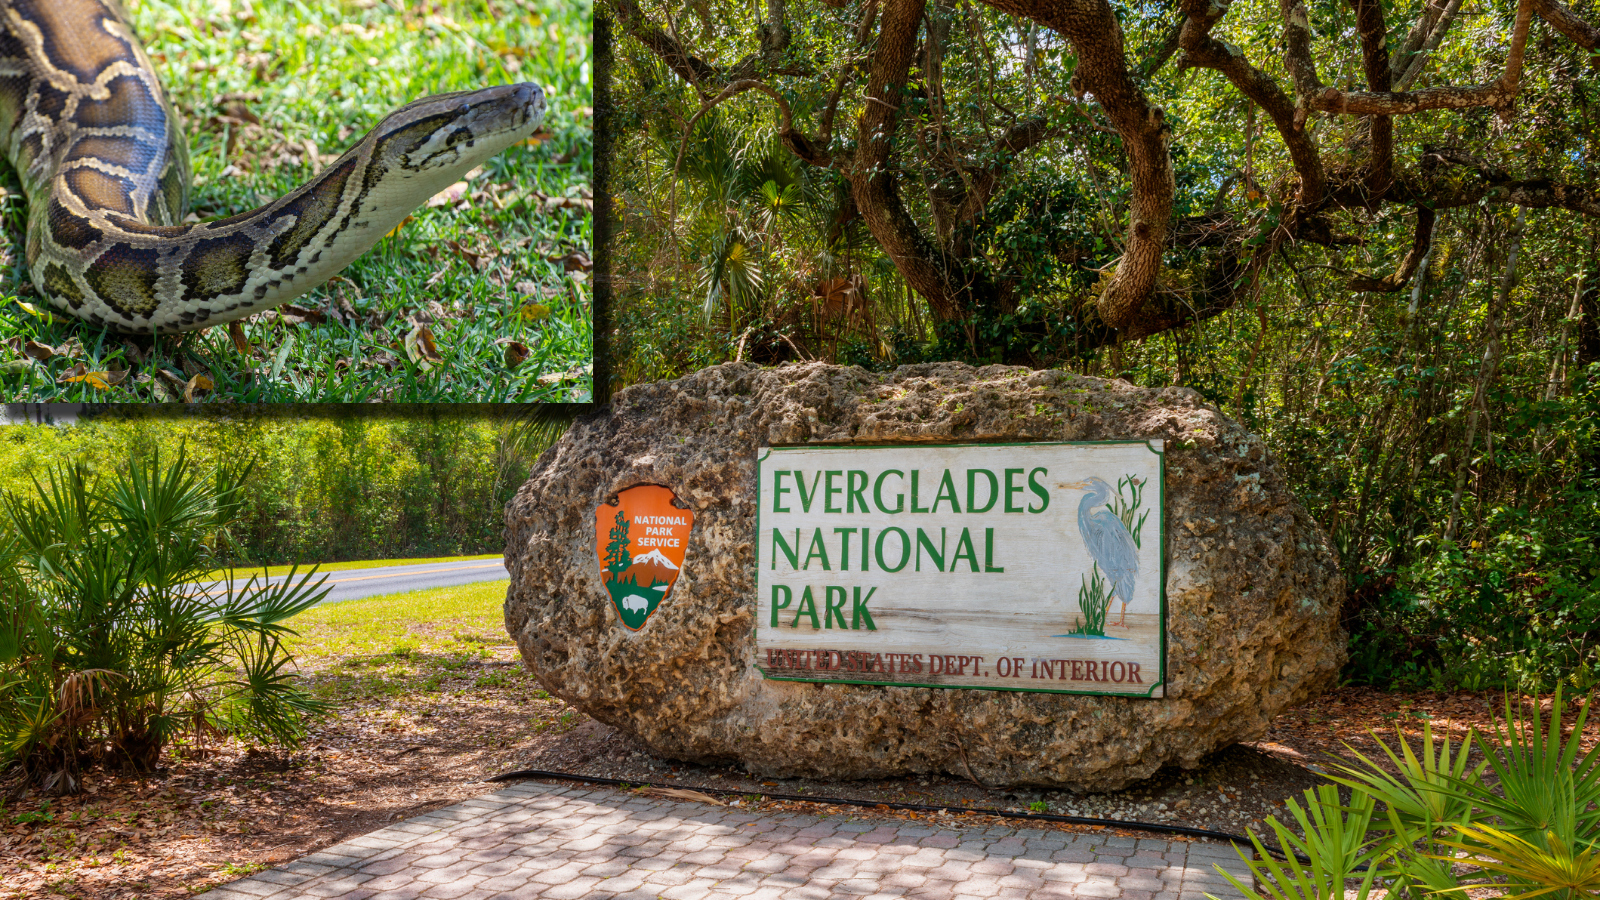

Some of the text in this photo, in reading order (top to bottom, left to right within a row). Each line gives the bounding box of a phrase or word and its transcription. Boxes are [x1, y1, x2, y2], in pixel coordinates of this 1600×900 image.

[773, 466, 1050, 514] EVERGLADES
[634, 515, 687, 526] NATIONAL
[645, 526, 673, 536] PARK
[637, 537, 680, 548] SERVICE
[771, 526, 1005, 573] NATIONAL
[770, 584, 878, 631] PARK
[766, 648, 1143, 684] UNITED STATES DEPT. OF INTERIOR
